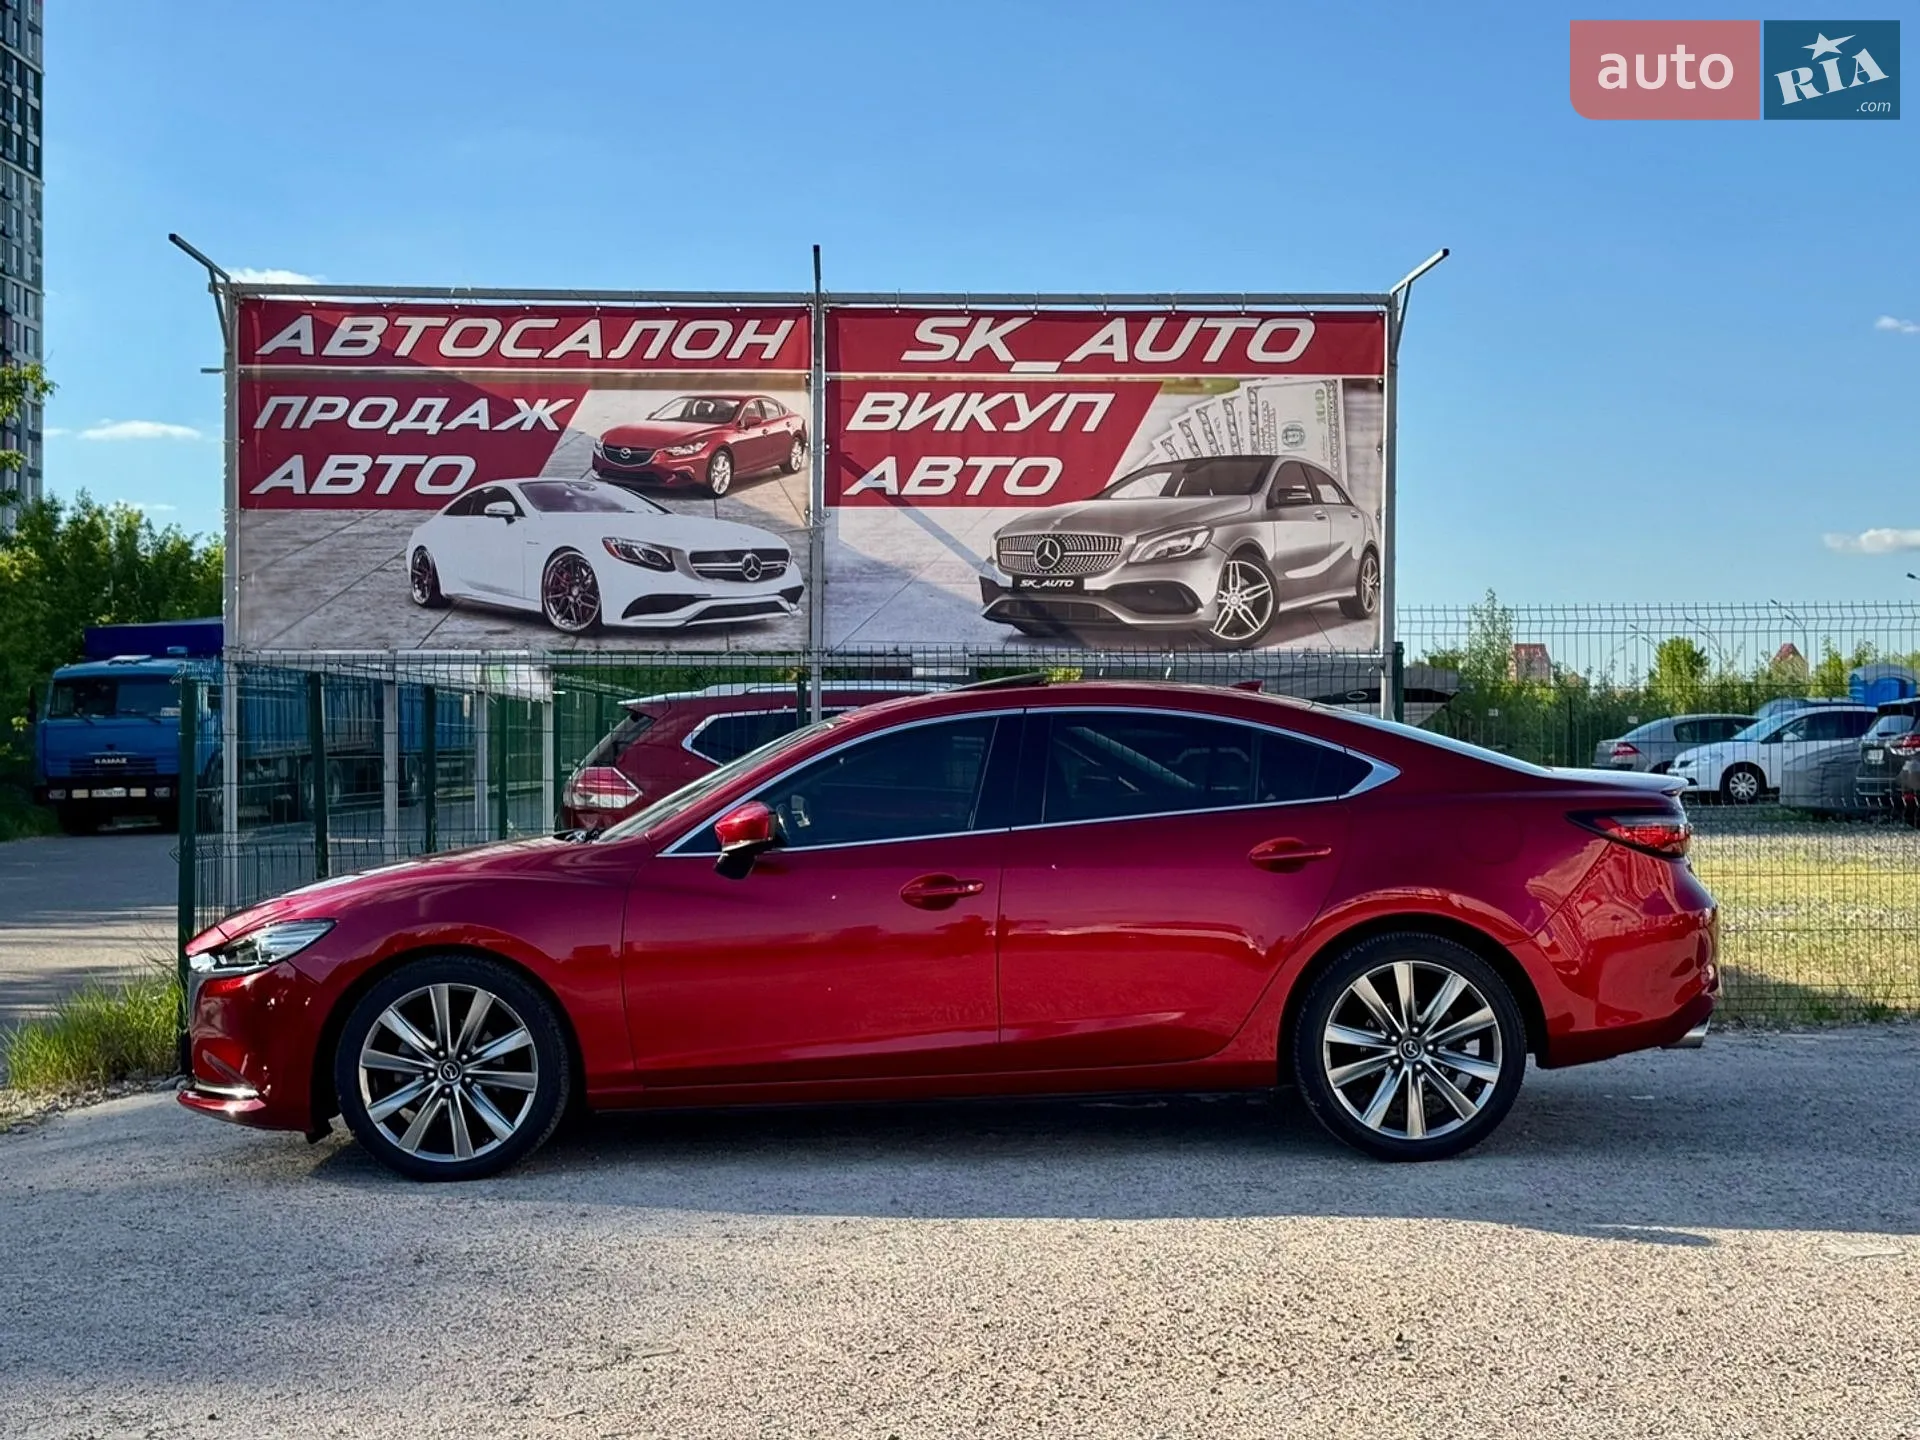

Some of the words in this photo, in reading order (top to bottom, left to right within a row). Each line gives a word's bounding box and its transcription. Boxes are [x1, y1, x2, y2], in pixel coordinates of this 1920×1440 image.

[255, 314, 796, 360] АВТОСАЛОН
[253, 396, 575, 434] ПРОДАЖ
[845, 392, 1116, 433] ВИКУП
[250, 454, 477, 495] АВТО
[843, 455, 1063, 497] АВТО
